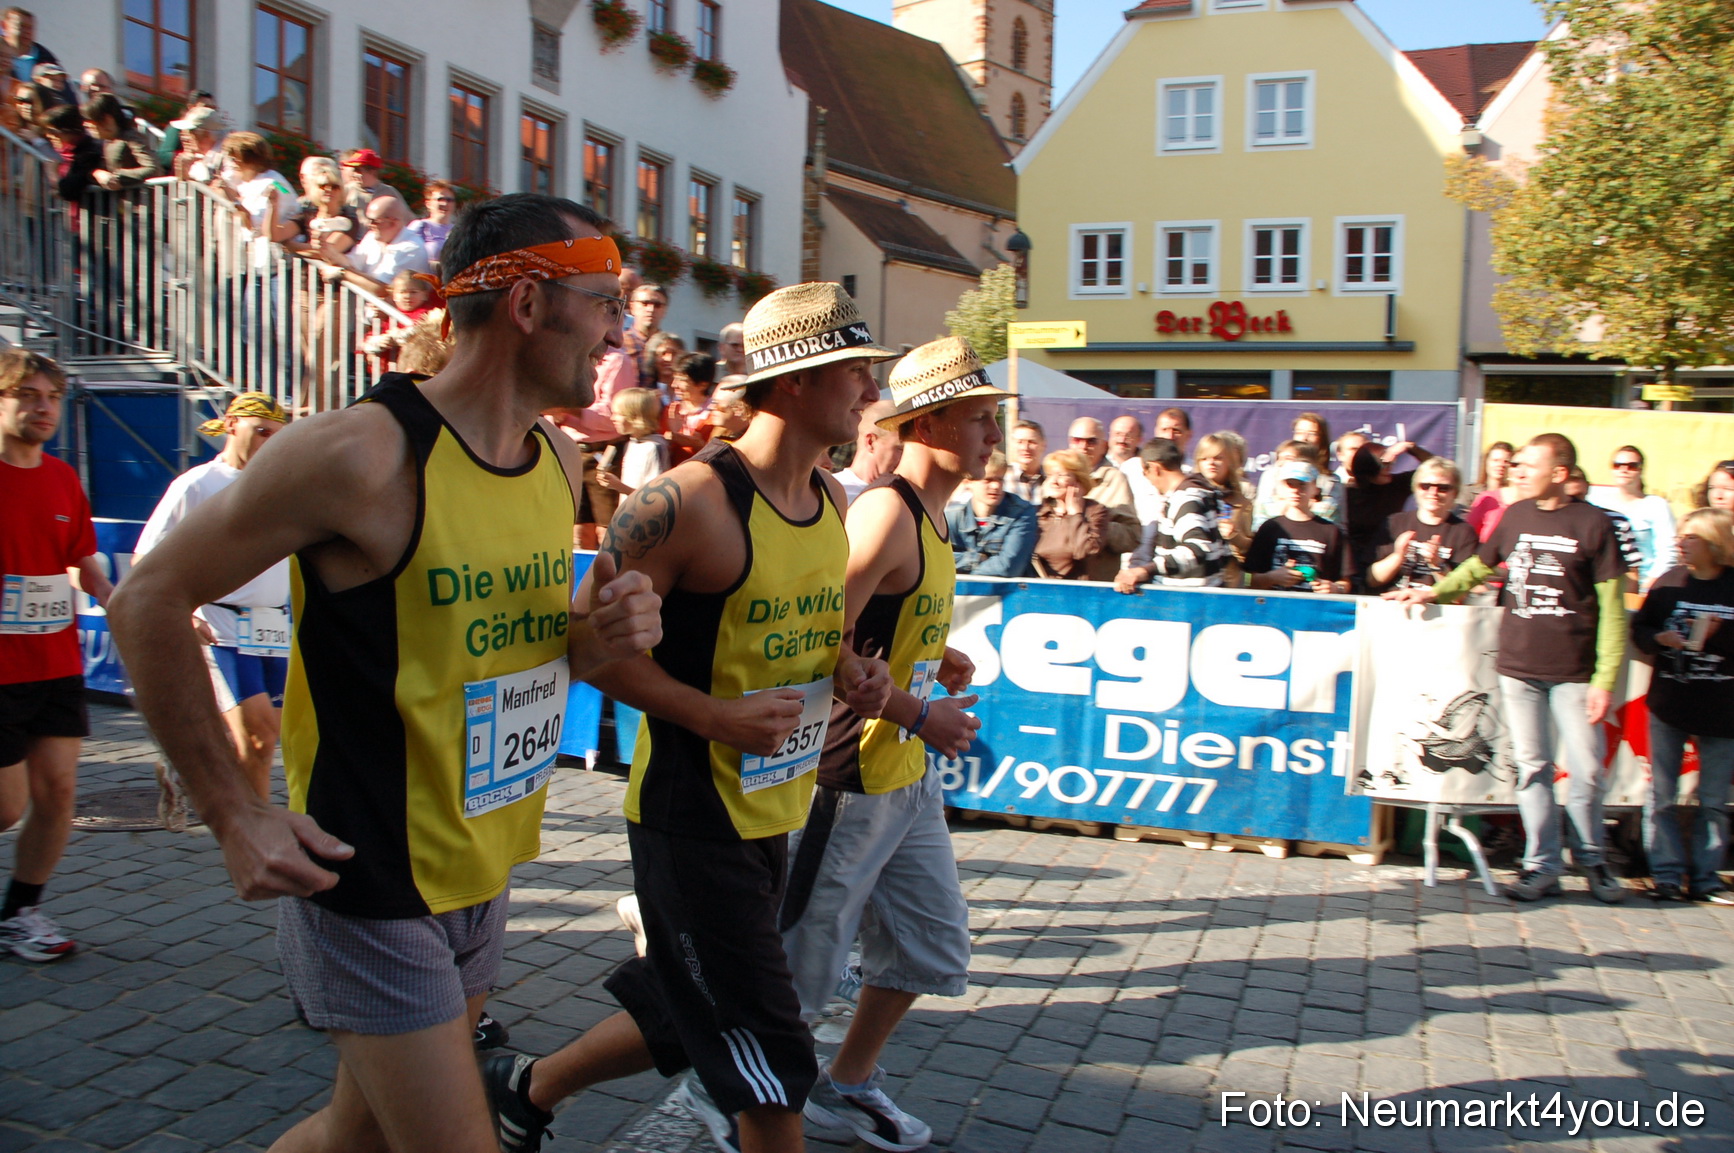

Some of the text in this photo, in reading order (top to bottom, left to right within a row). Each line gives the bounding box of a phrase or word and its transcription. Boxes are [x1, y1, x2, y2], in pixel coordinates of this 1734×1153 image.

[1156, 301, 1292, 341] Der Beck
[752, 329, 847, 370] MALLORCA
[427, 564, 494, 606] Die
[746, 585, 844, 623] Die wild
[915, 593, 944, 617] Die
[24, 601, 70, 618] 3168
[502, 672, 557, 713] Manfred
[472, 736, 480, 755] D
[503, 713, 560, 770] 2640
[1103, 714, 1352, 777] Dienst
[466, 785, 513, 811] BOCK
[930, 753, 1218, 815] 81/907777
